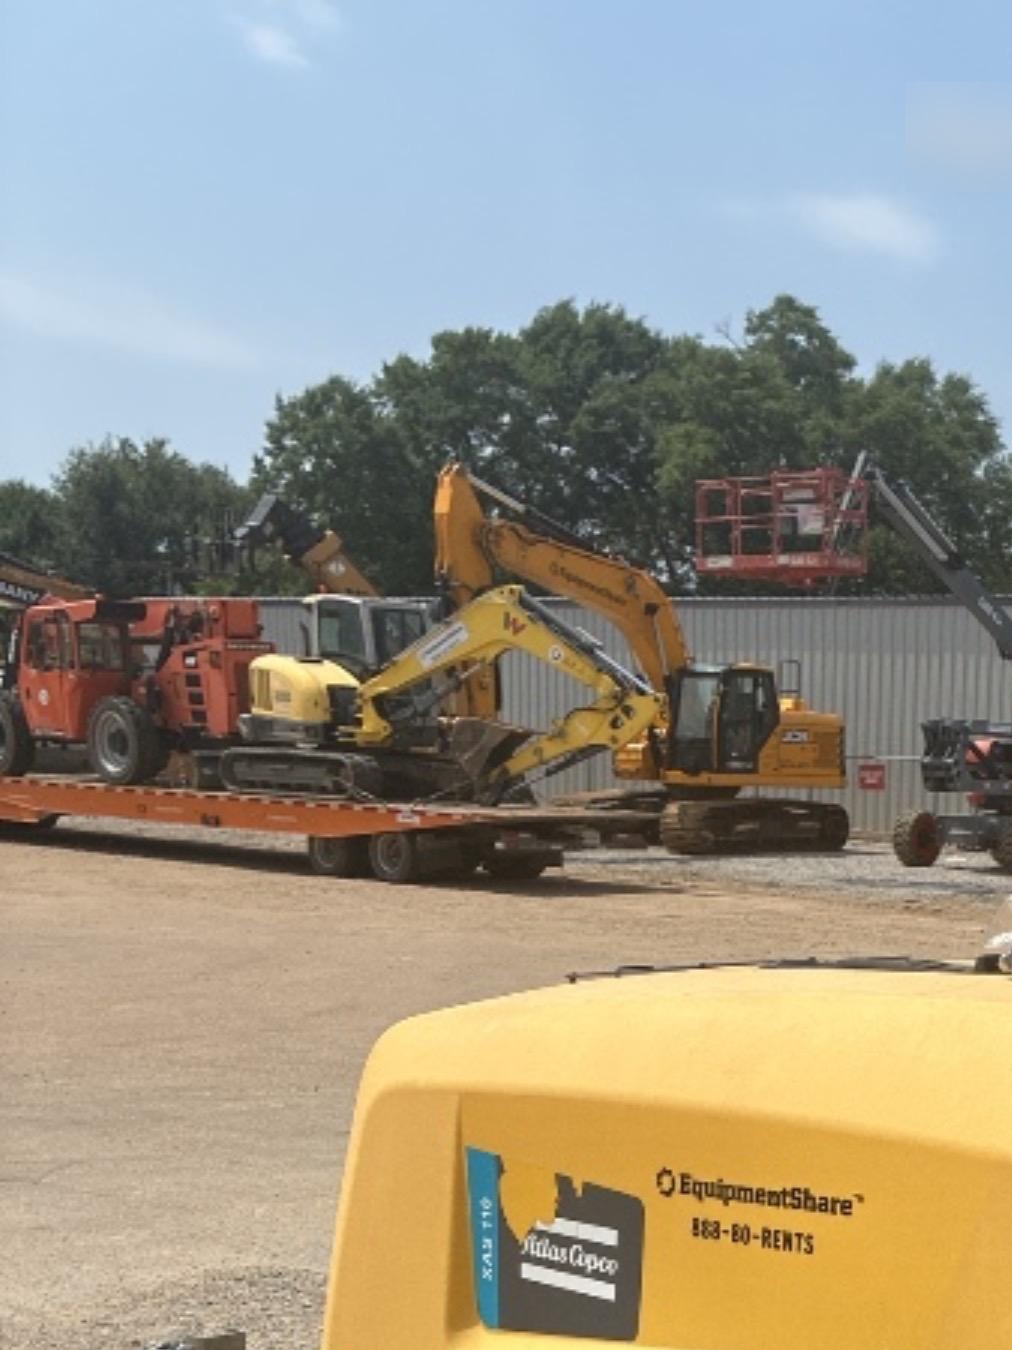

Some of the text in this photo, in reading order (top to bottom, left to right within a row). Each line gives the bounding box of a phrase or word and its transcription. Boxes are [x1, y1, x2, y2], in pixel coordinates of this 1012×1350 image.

[679, 1172, 854, 1216] EquipmentShare
[480, 1196, 494, 1281] XAS 110
[521, 1232, 618, 1276] Atlas Copco
[692, 1217, 815, 1255] 888-80-RENTS
